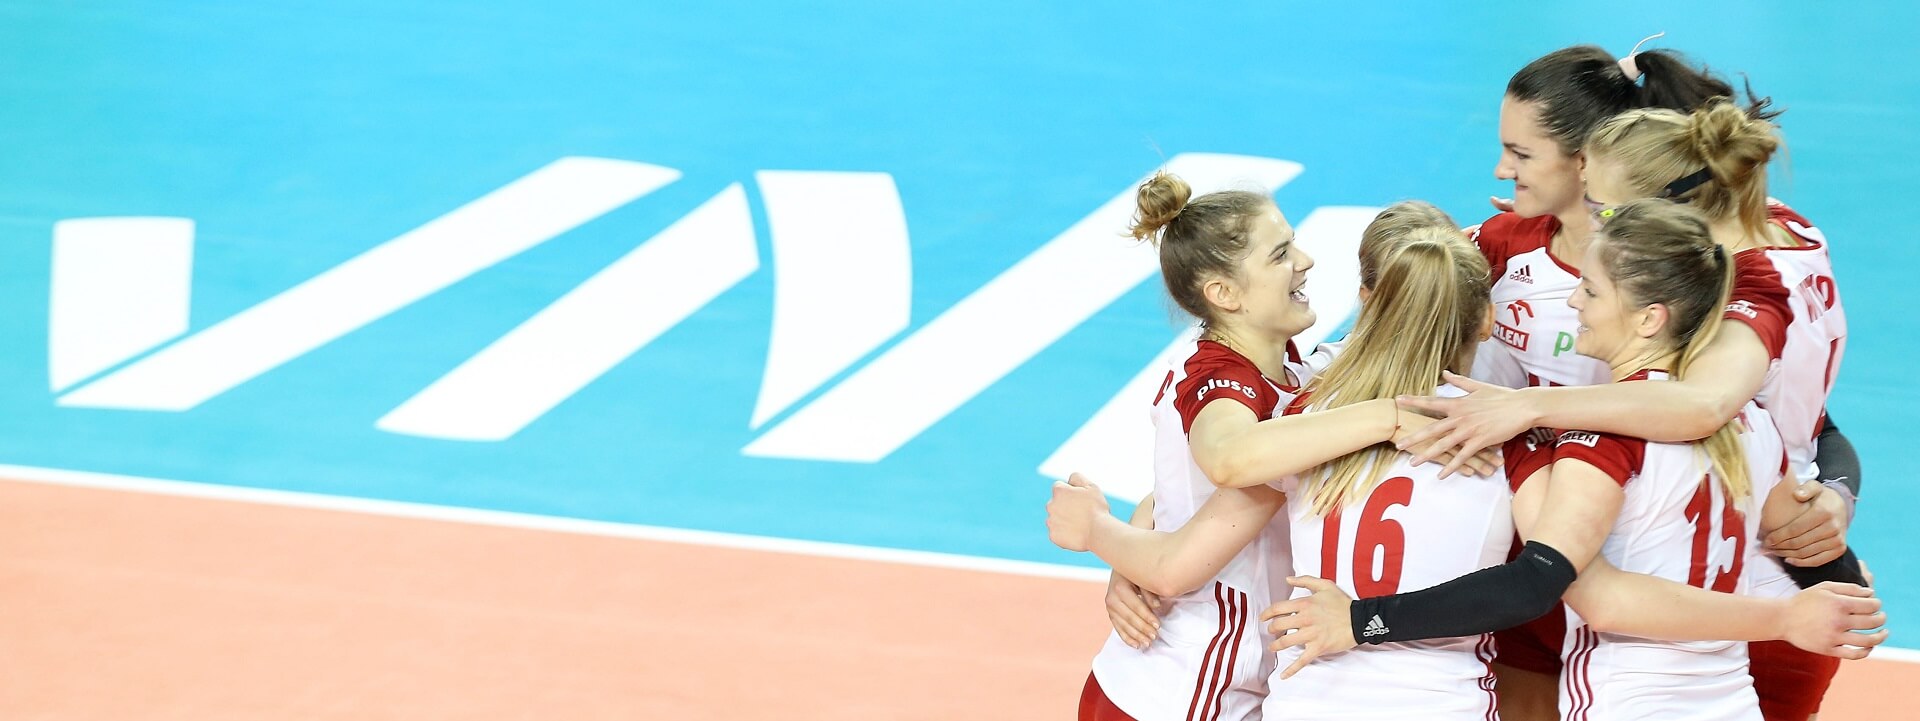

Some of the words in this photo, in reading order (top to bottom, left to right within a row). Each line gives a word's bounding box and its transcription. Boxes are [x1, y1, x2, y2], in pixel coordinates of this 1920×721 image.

[1509, 273, 1534, 285] adidas
[1493, 323, 1526, 349] RLEN
[1196, 378, 1242, 401] plus
[1313, 476, 1415, 600] 16
[1684, 473, 1747, 594] 15
[1362, 626, 1390, 637] adidas
